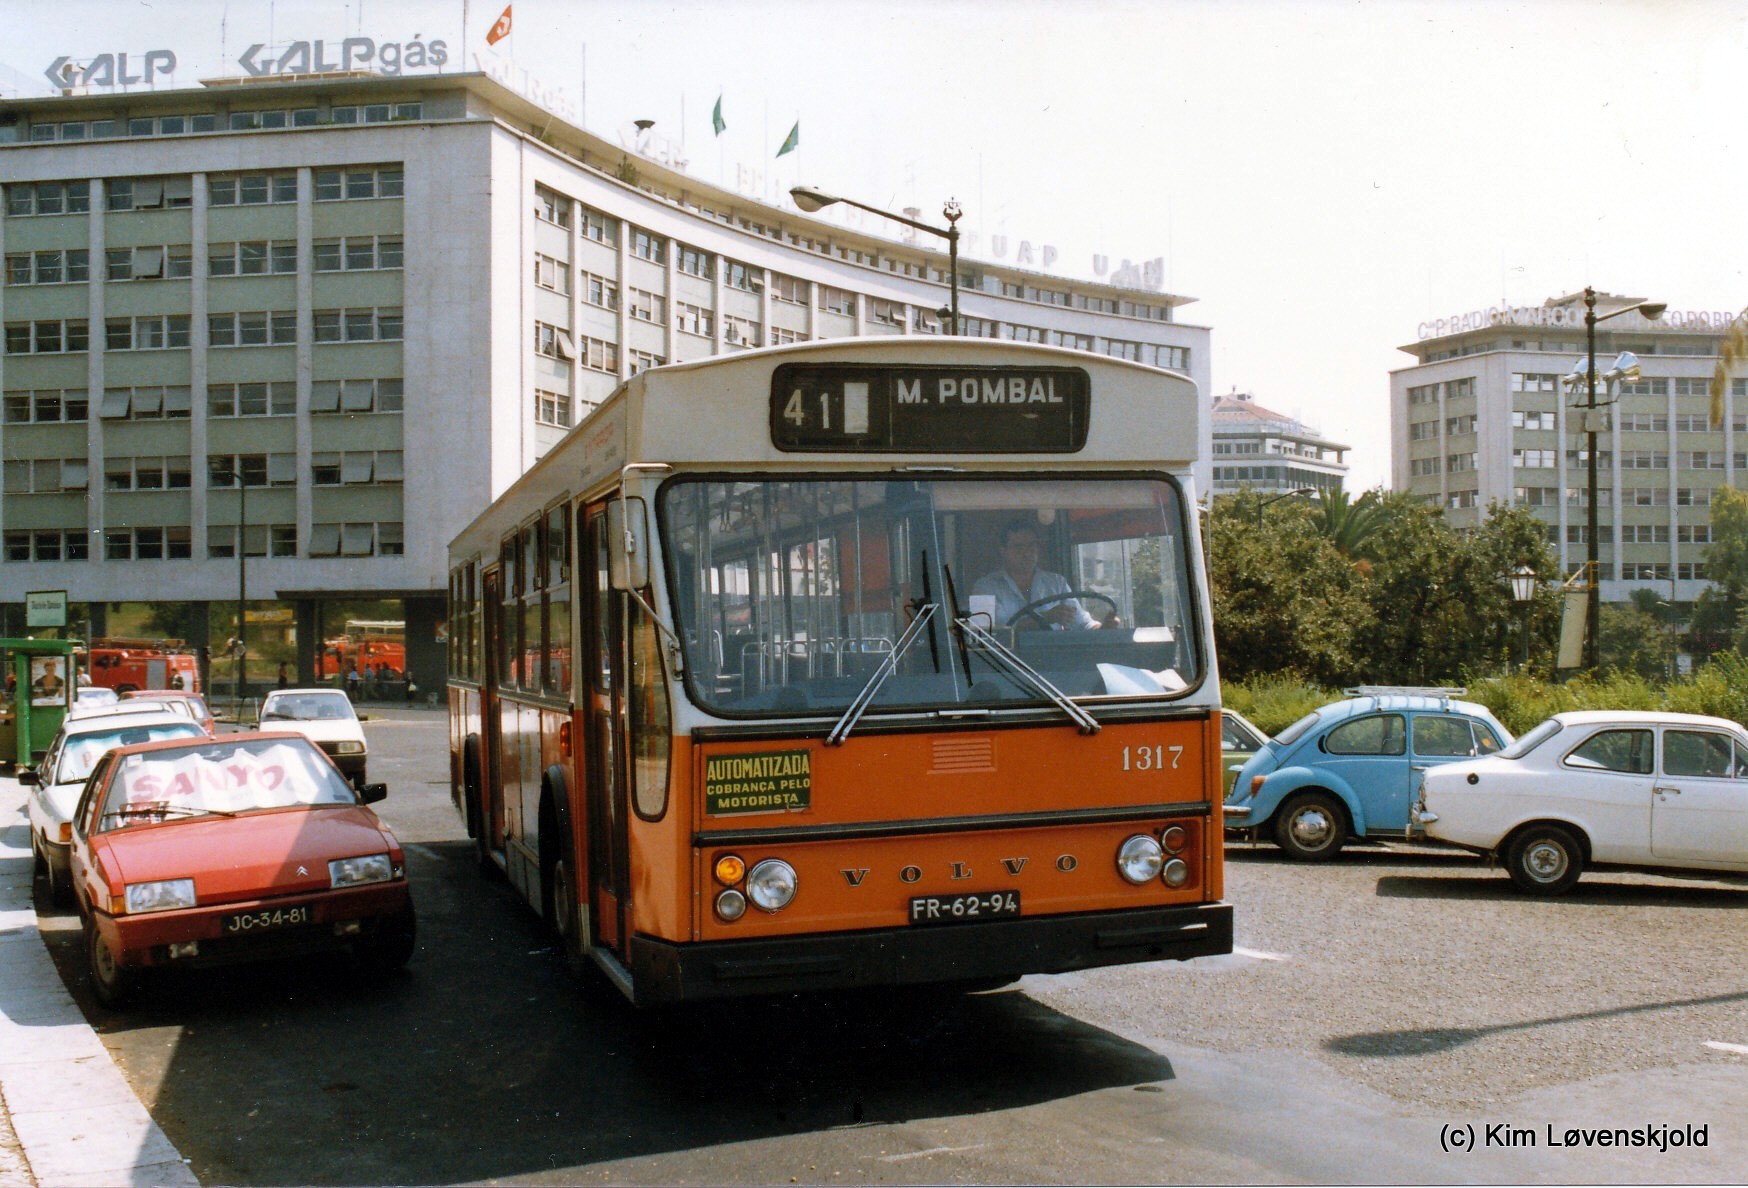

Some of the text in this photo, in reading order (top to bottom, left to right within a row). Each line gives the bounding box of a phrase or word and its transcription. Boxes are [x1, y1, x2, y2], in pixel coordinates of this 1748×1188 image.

[45, 49, 177, 89] GALP
[897, 378, 928, 404] M.
[939, 377, 1064, 405] POMBAL
[707, 755, 810, 780] AUTOMATIZADA
[1123, 745, 1183, 771] 1317
[132, 765, 285, 802] SANYO
[707, 778, 810, 796] COBRANÇA PELO
[718, 793, 799, 808] MOTORISTA
[842, 853, 1078, 888] VOLVO
[228, 907, 308, 933] JC-34-81
[911, 894, 1018, 921] FR-62-94
